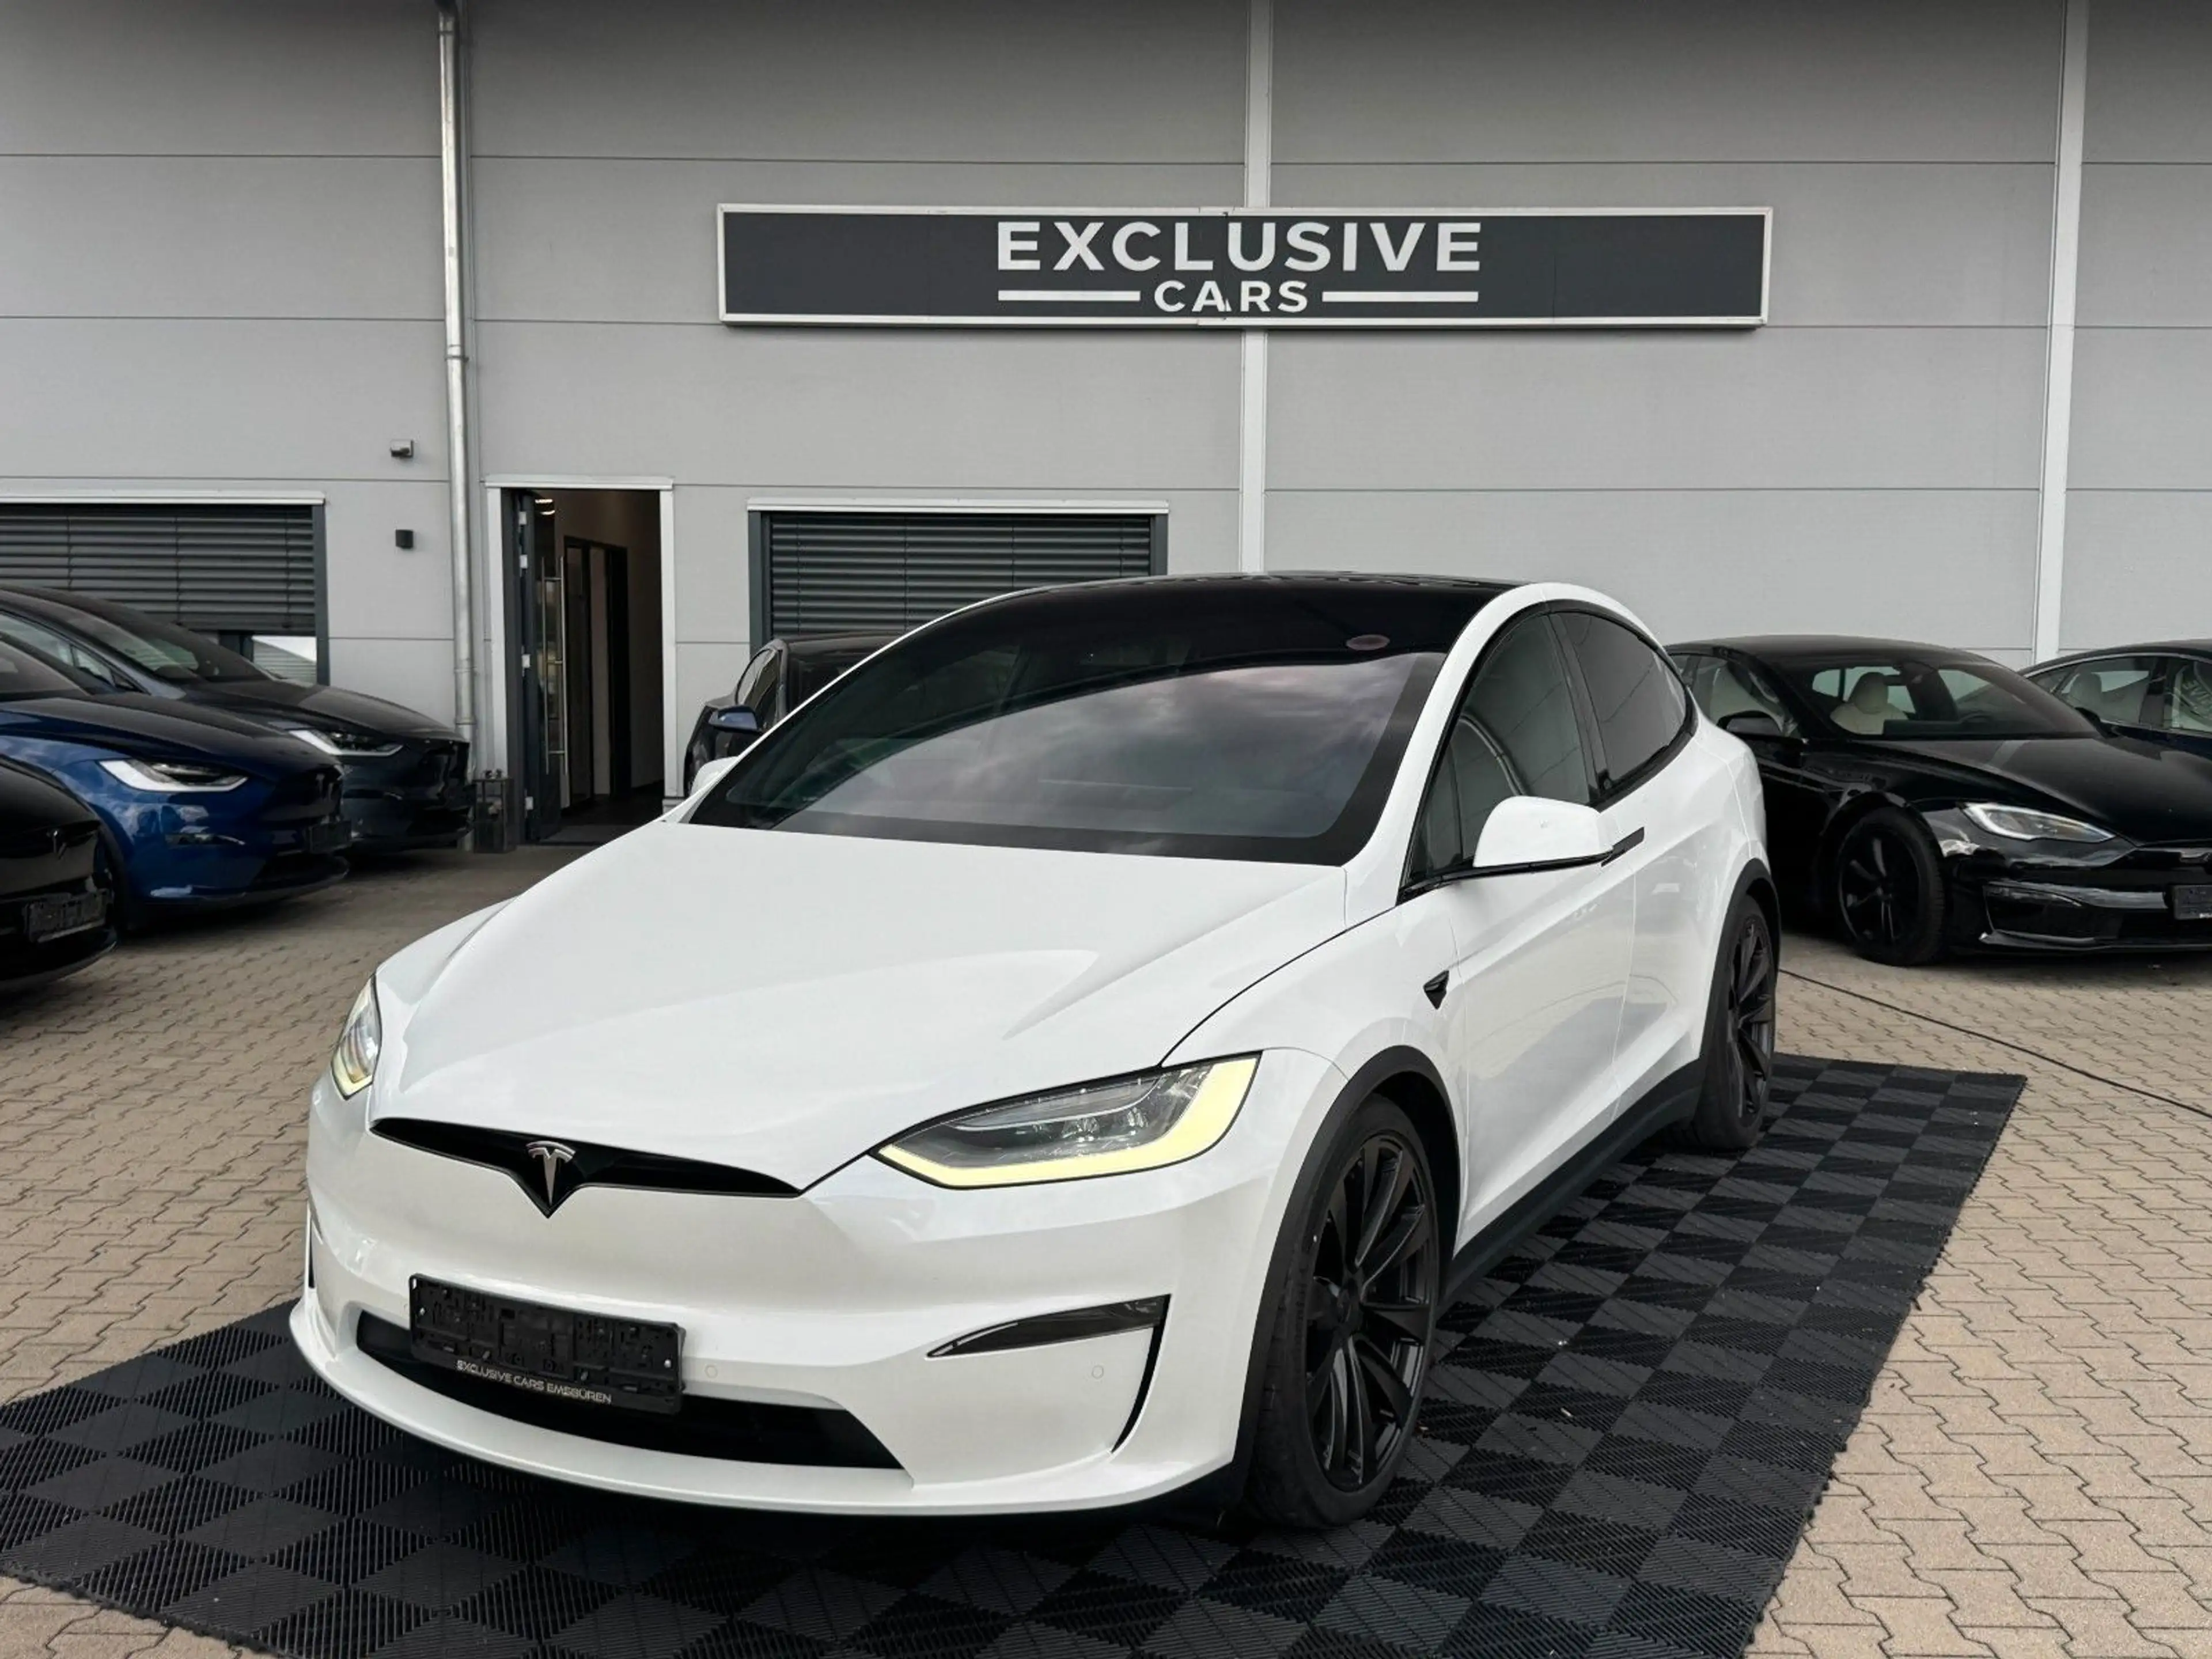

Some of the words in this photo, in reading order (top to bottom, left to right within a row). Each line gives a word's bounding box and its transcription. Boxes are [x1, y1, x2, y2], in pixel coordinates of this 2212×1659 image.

[998, 221, 1481, 271] EXCLUSIVE
[1154, 280, 1308, 313] CARS
[456, 1359, 512, 1384] EXCLUSIVE
[513, 1375, 544, 1391] CARS
